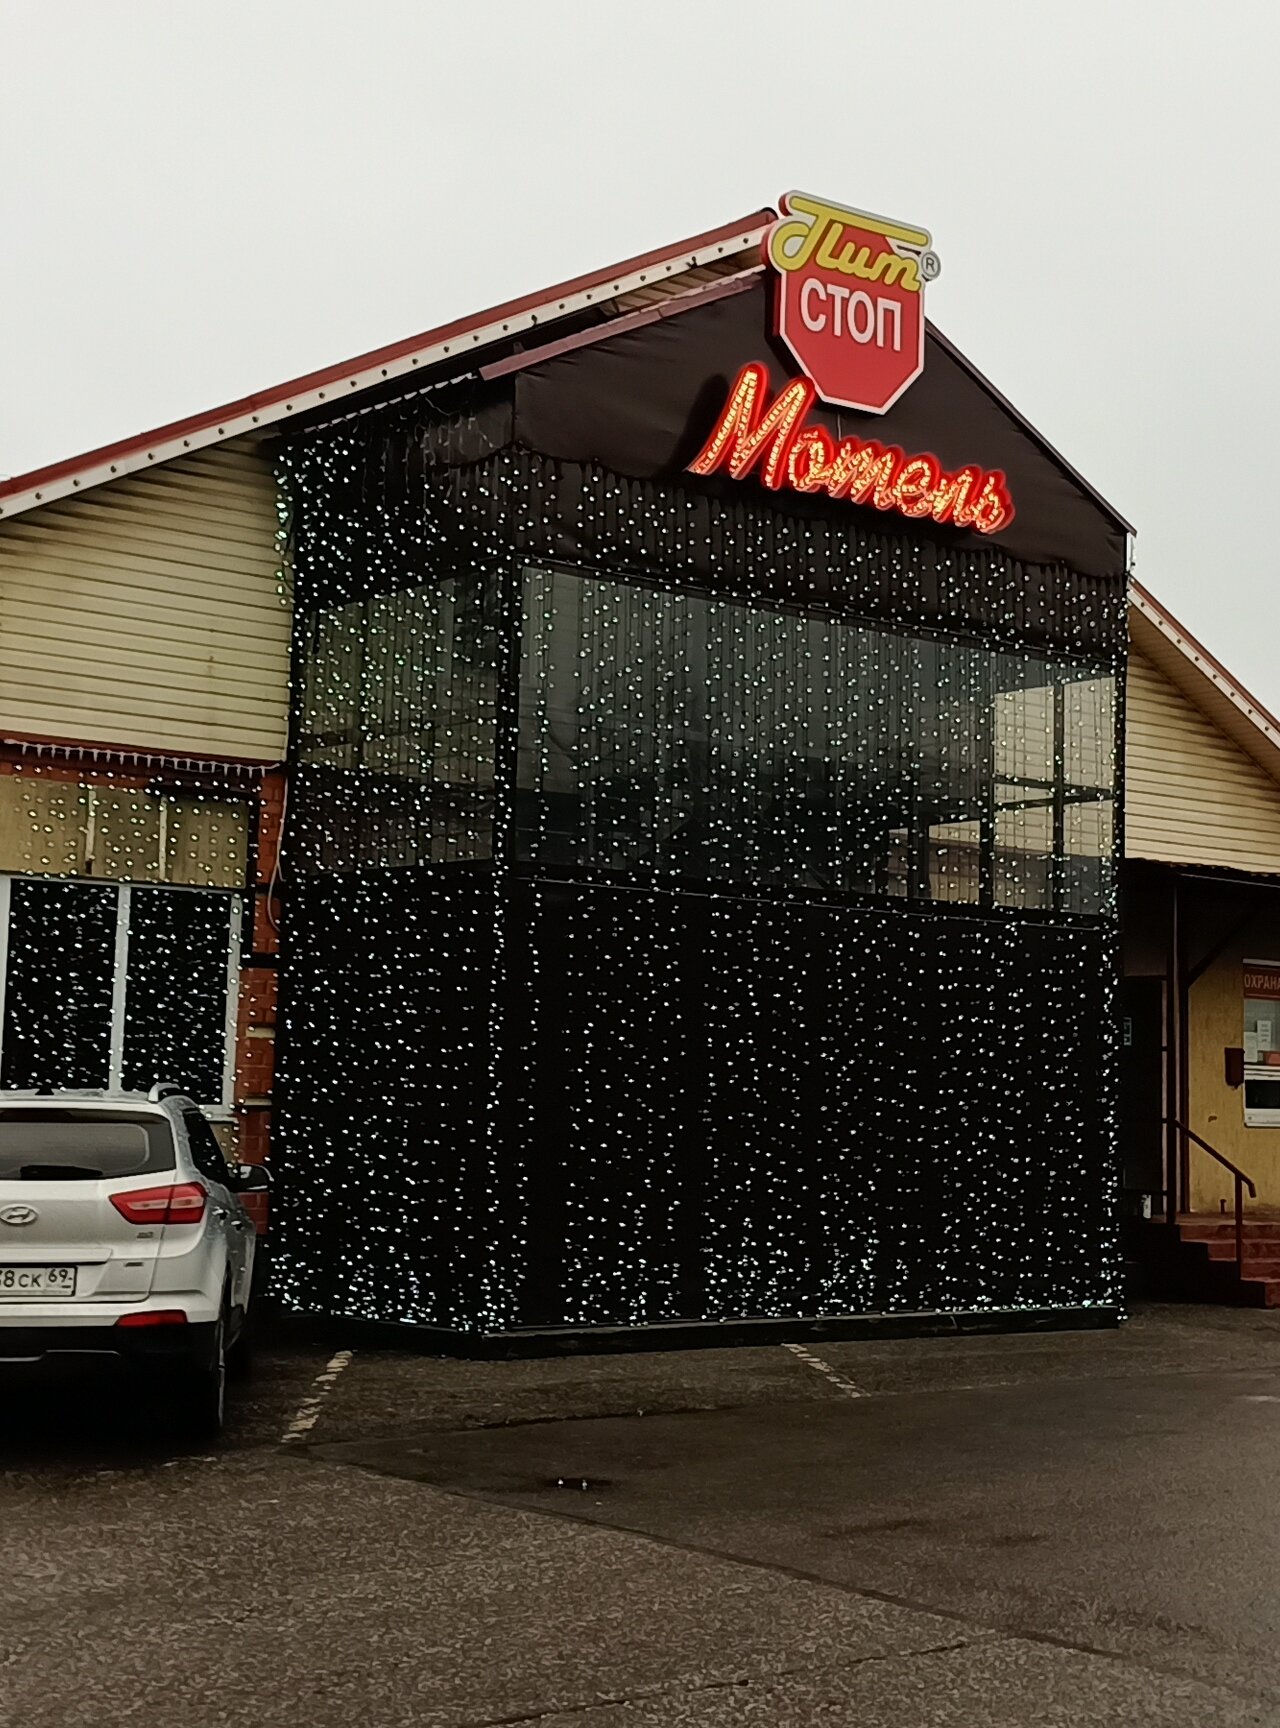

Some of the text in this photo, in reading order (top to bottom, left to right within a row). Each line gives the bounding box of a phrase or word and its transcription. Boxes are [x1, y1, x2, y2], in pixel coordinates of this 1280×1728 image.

[772, 196, 929, 291] Пит
[801, 278, 901, 351] СТОП
[689, 362, 1015, 533] Мотель
